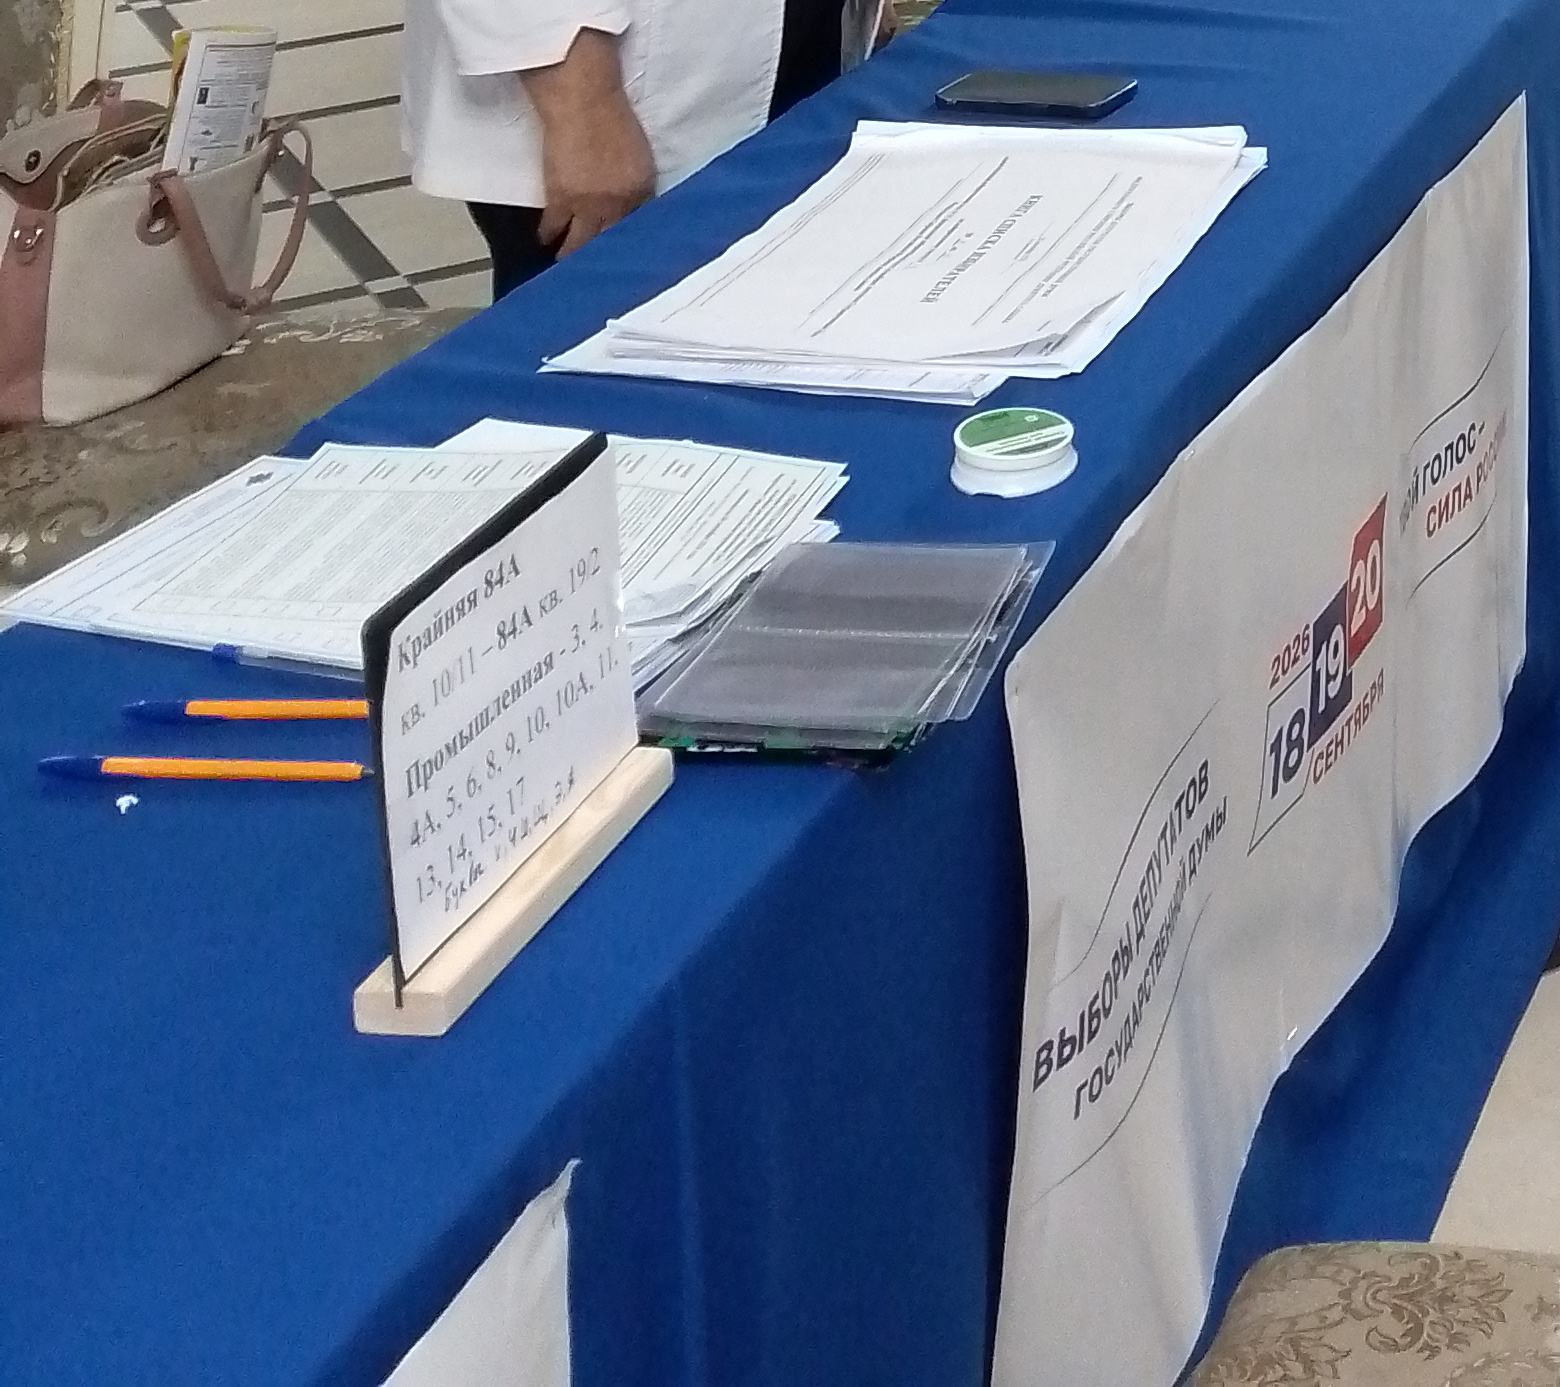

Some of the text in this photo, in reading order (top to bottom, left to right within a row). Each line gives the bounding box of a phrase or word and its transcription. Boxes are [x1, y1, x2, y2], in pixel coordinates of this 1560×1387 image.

[1421, 422, 1477, 497] ГОЛОС
[1426, 475, 1473, 539] СИЛА
[397, 553, 521, 673] Крайняя 84А
[401, 703, 426, 736] кв.
[496, 606, 534, 651] 84А
[538, 589, 563, 619] кв.
[1268, 624, 1311, 690] 2026
[1269, 539, 1381, 800] 18 19 20
[405, 651, 555, 798] Промышленная
[1312, 668, 1385, 786] СЕНТЯБРЯ
[507, 776, 524, 816] 17
[1032, 759, 1209, 1094] ВЫБОРЫ ДЕПУТАТОВ
[1073, 795, 1229, 1121] ГОСУДАРСТВЕННОЙ ДУМЫ
